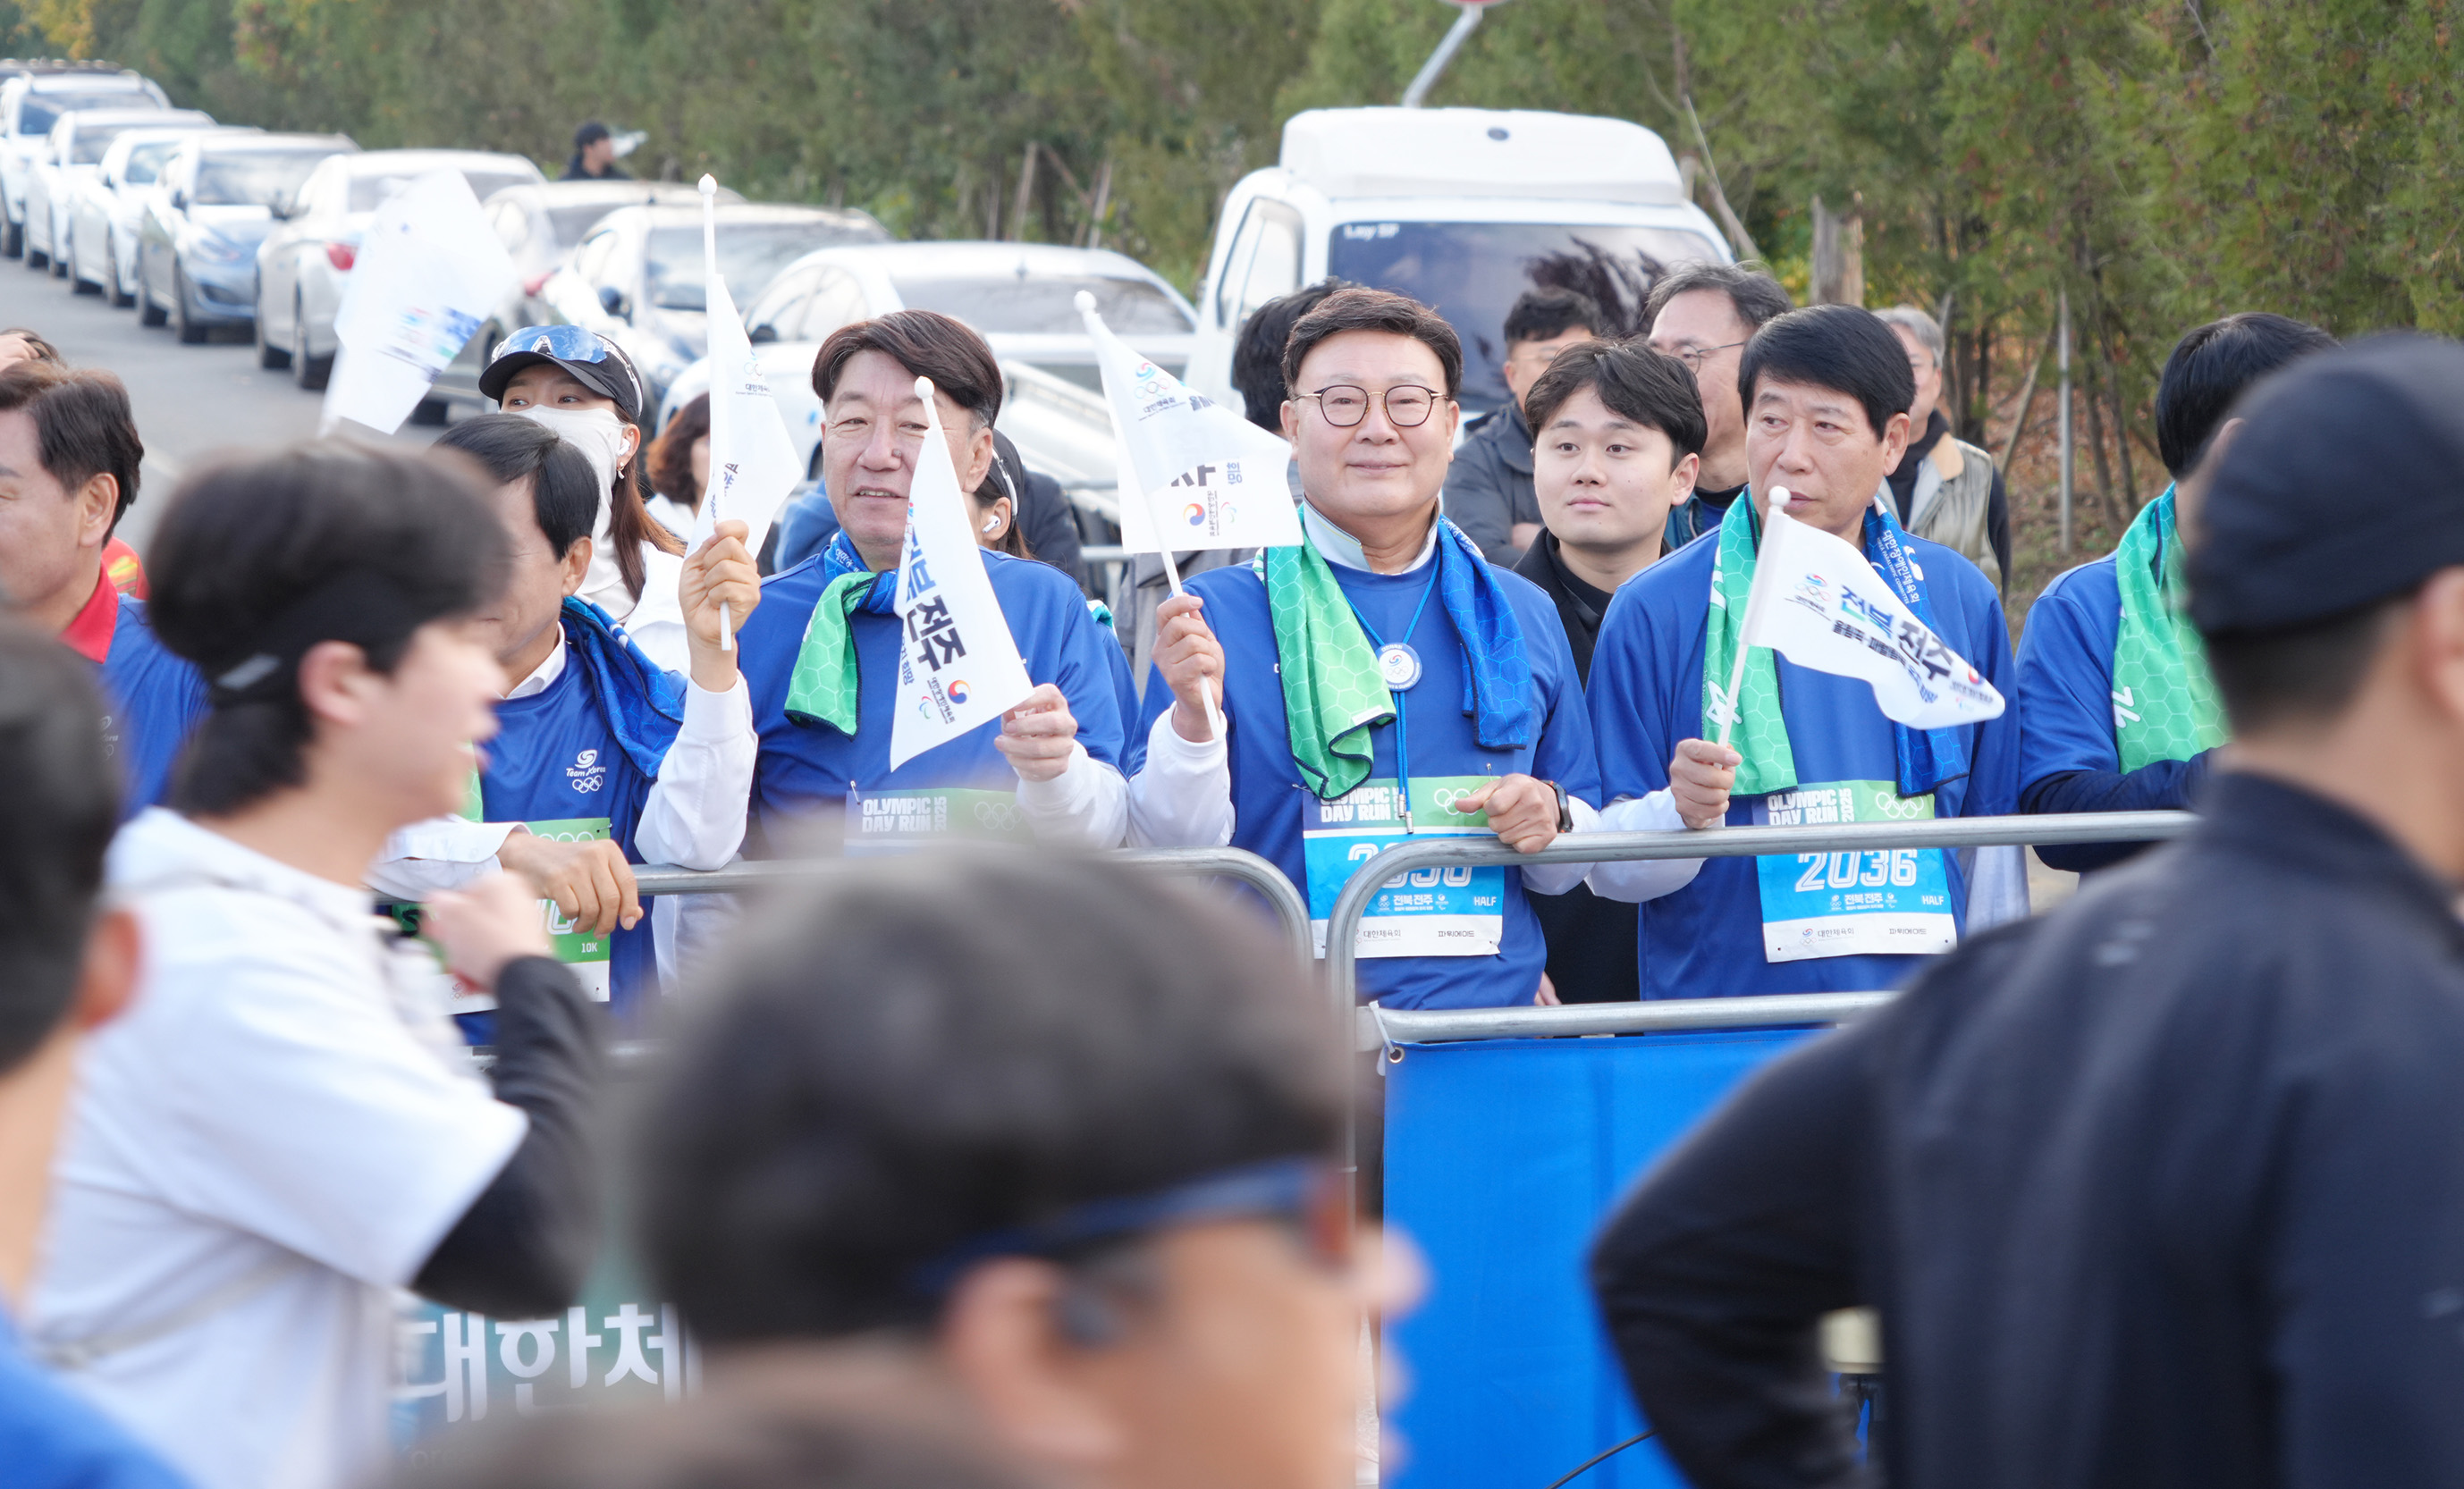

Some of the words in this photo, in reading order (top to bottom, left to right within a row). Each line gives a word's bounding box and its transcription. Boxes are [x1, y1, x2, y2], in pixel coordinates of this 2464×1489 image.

[1882, 529, 1920, 603] 대한장애인체육회
[907, 595, 966, 672] 전주
[1898, 620, 1954, 681] 전주
[566, 767, 585, 778] Team
[584, 766, 606, 776] Korea
[862, 797, 931, 815] OLYMPIC
[1768, 789, 1837, 812] OLYMPIC
[1838, 787, 1854, 822] 2025
[933, 796, 948, 832] 2025
[1321, 805, 1354, 823] DAY
[1357, 803, 1391, 821] RUN
[1769, 810, 1802, 826] DAY
[1805, 805, 1838, 825] RUN
[862, 815, 895, 832] DAY
[899, 814, 931, 832] RUN
[1794, 848, 1918, 893] 2036
[1393, 895, 1413, 905] 전북
[1413, 894, 1433, 905] 전주
[1473, 896, 1497, 906] HALF
[1844, 894, 1864, 905] 전북
[1864, 893, 1884, 904] 전주
[1922, 896, 1944, 905] HALF
[1363, 930, 1402, 938] 대한체육회
[1818, 928, 1855, 938] 대한체육회
[581, 942, 598, 953] 10K
